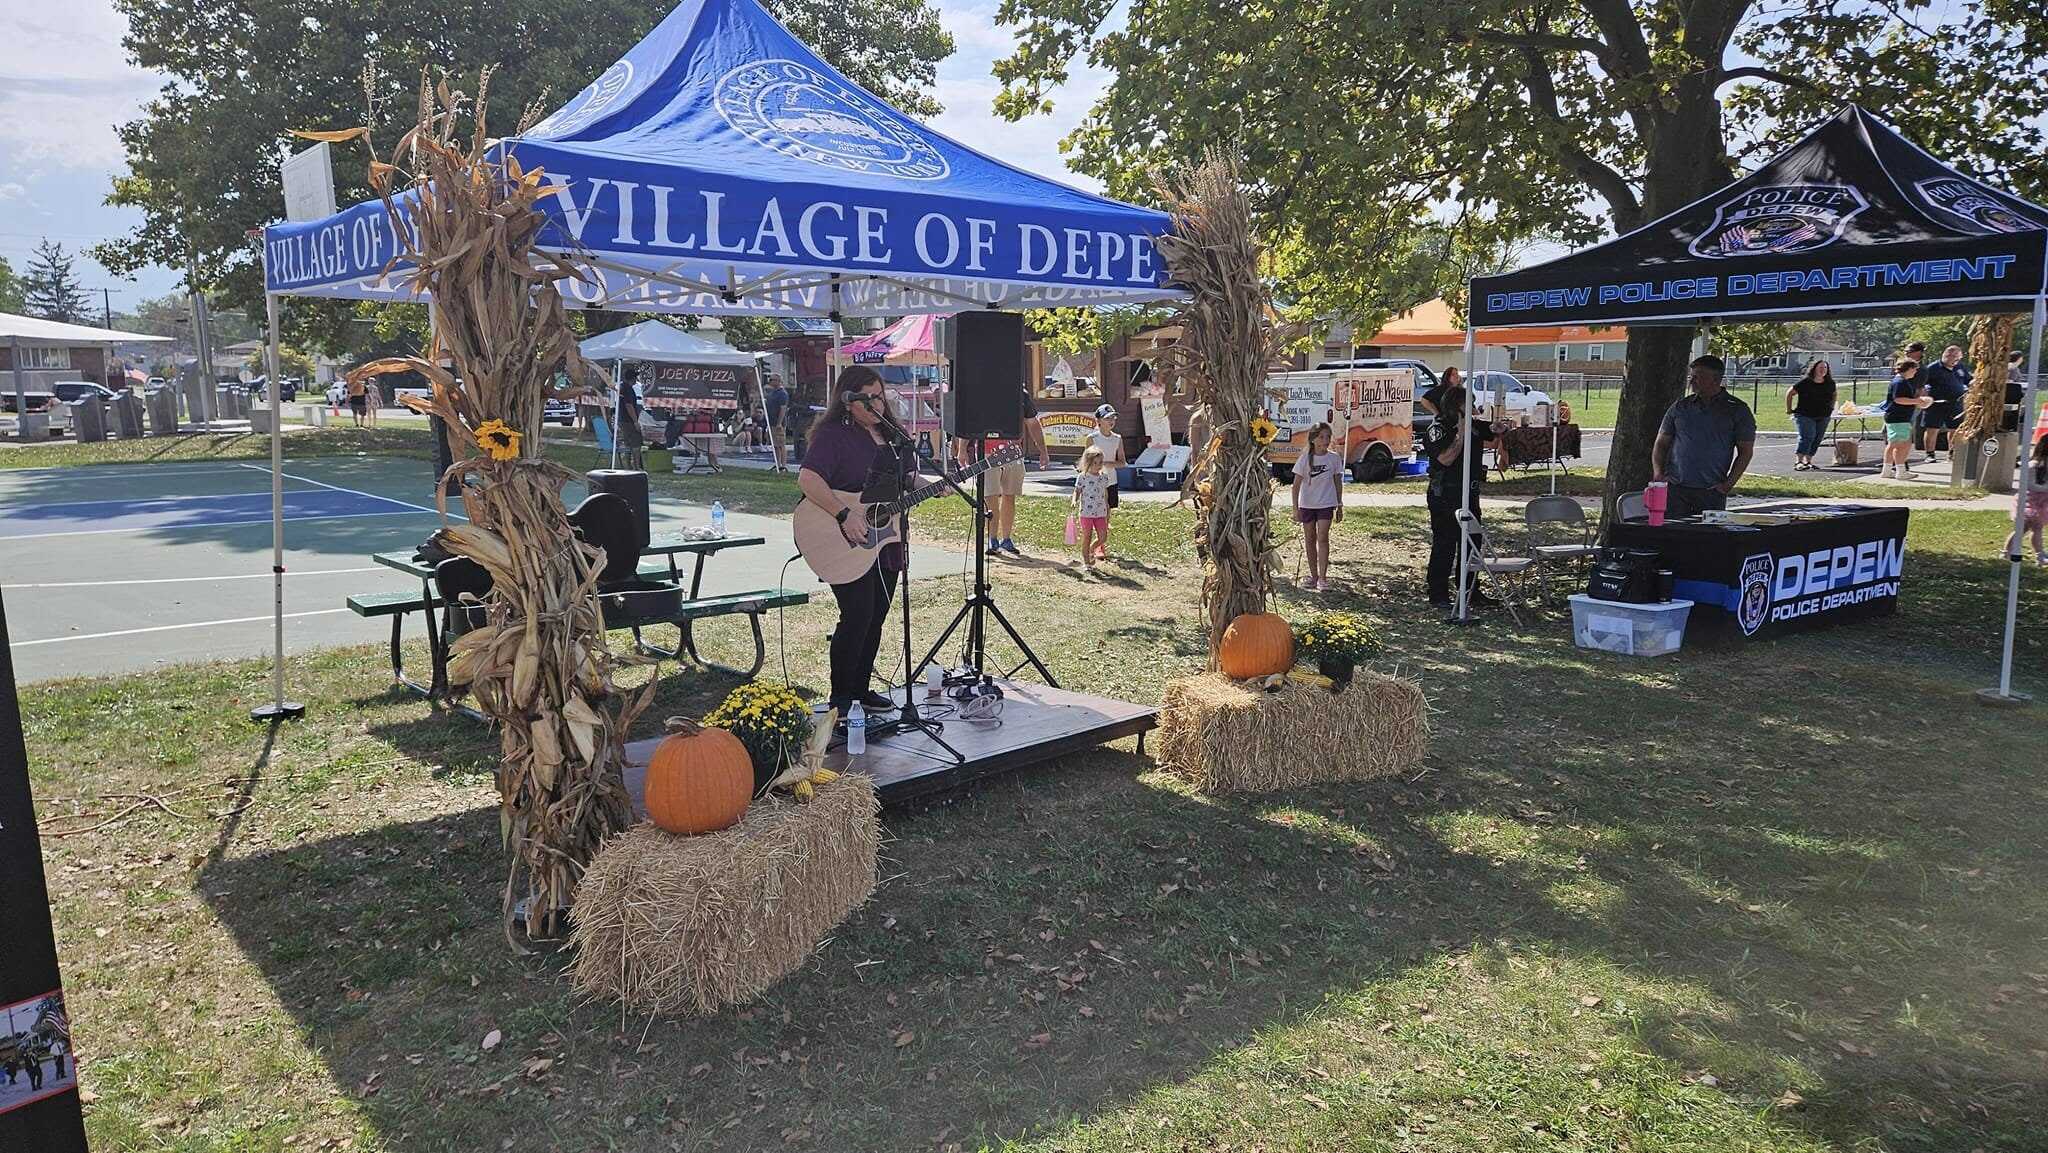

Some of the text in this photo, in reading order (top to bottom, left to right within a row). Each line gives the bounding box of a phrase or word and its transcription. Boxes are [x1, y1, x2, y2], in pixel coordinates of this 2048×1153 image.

[1744, 189, 1845, 206] POLICE
[1745, 205, 1825, 217] DEPEW
[543, 172, 1156, 284] VILLAGE OF DEPE
[269, 223, 348, 285] VILLAGE
[353, 213, 383, 272] OF
[1487, 254, 2016, 313] DEPEW POLICE DEPARTMENT
[659, 367, 736, 382] JOEY'S PIZZA
[1384, 379, 1411, 404] Wagon
[1745, 559, 1770, 575] POLICE
[1773, 536, 1908, 602] DEPEW
[1771, 580, 1901, 623] POLICE DEPARTMEN
